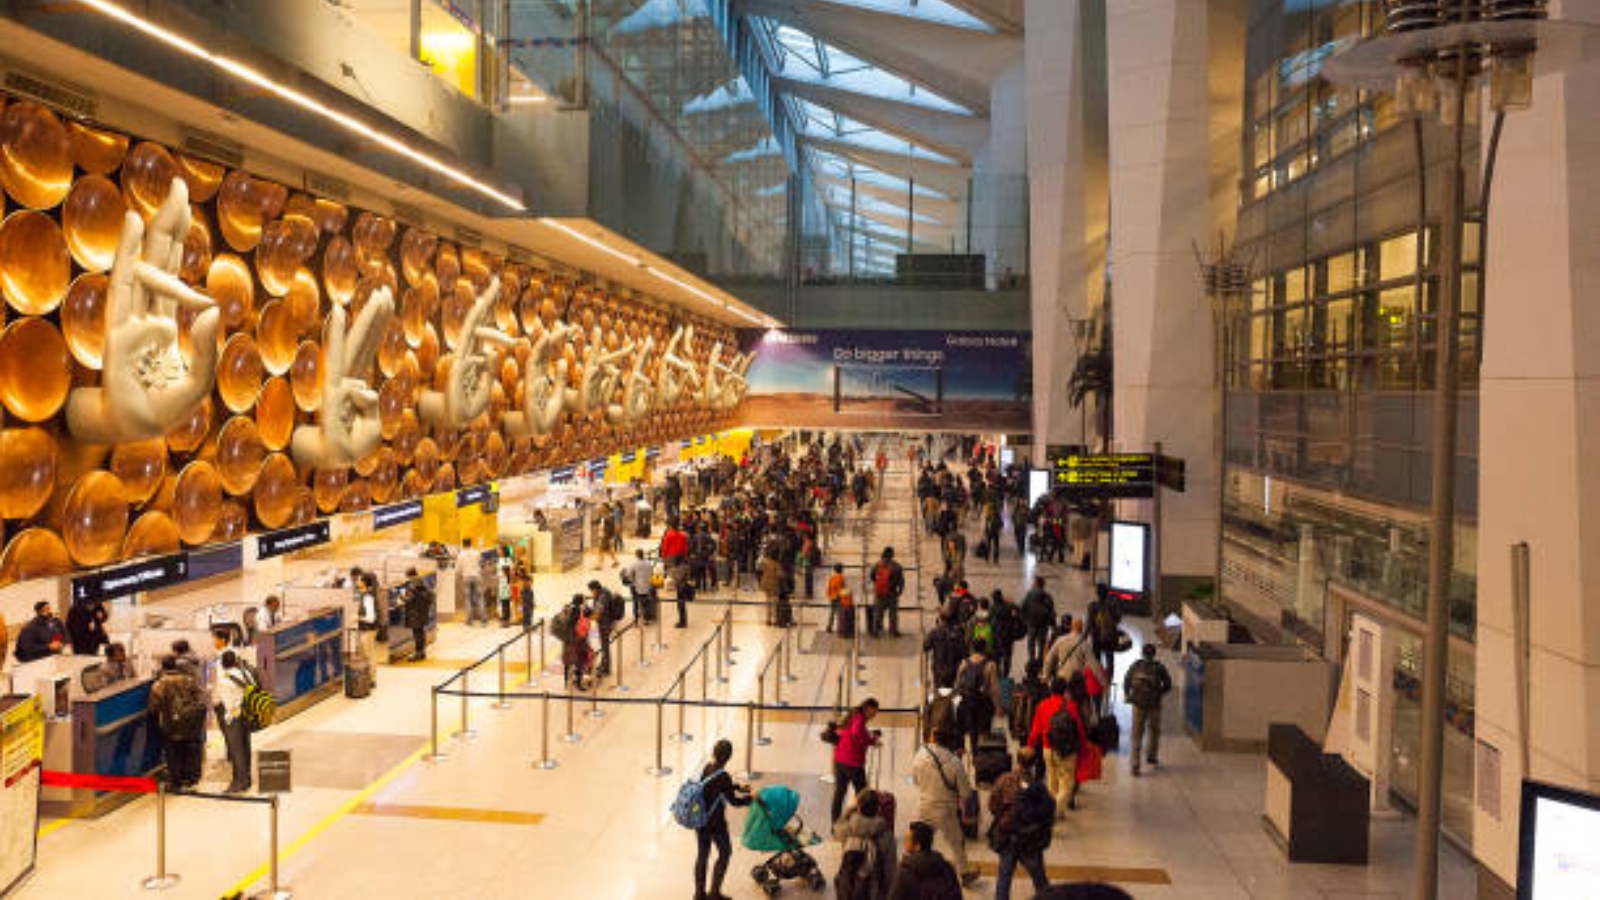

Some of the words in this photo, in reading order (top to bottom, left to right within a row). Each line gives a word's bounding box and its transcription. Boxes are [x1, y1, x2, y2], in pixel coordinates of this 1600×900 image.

[833, 347, 852, 360] Do
[854, 347, 899, 362] bigger
[903, 348, 943, 364] things
